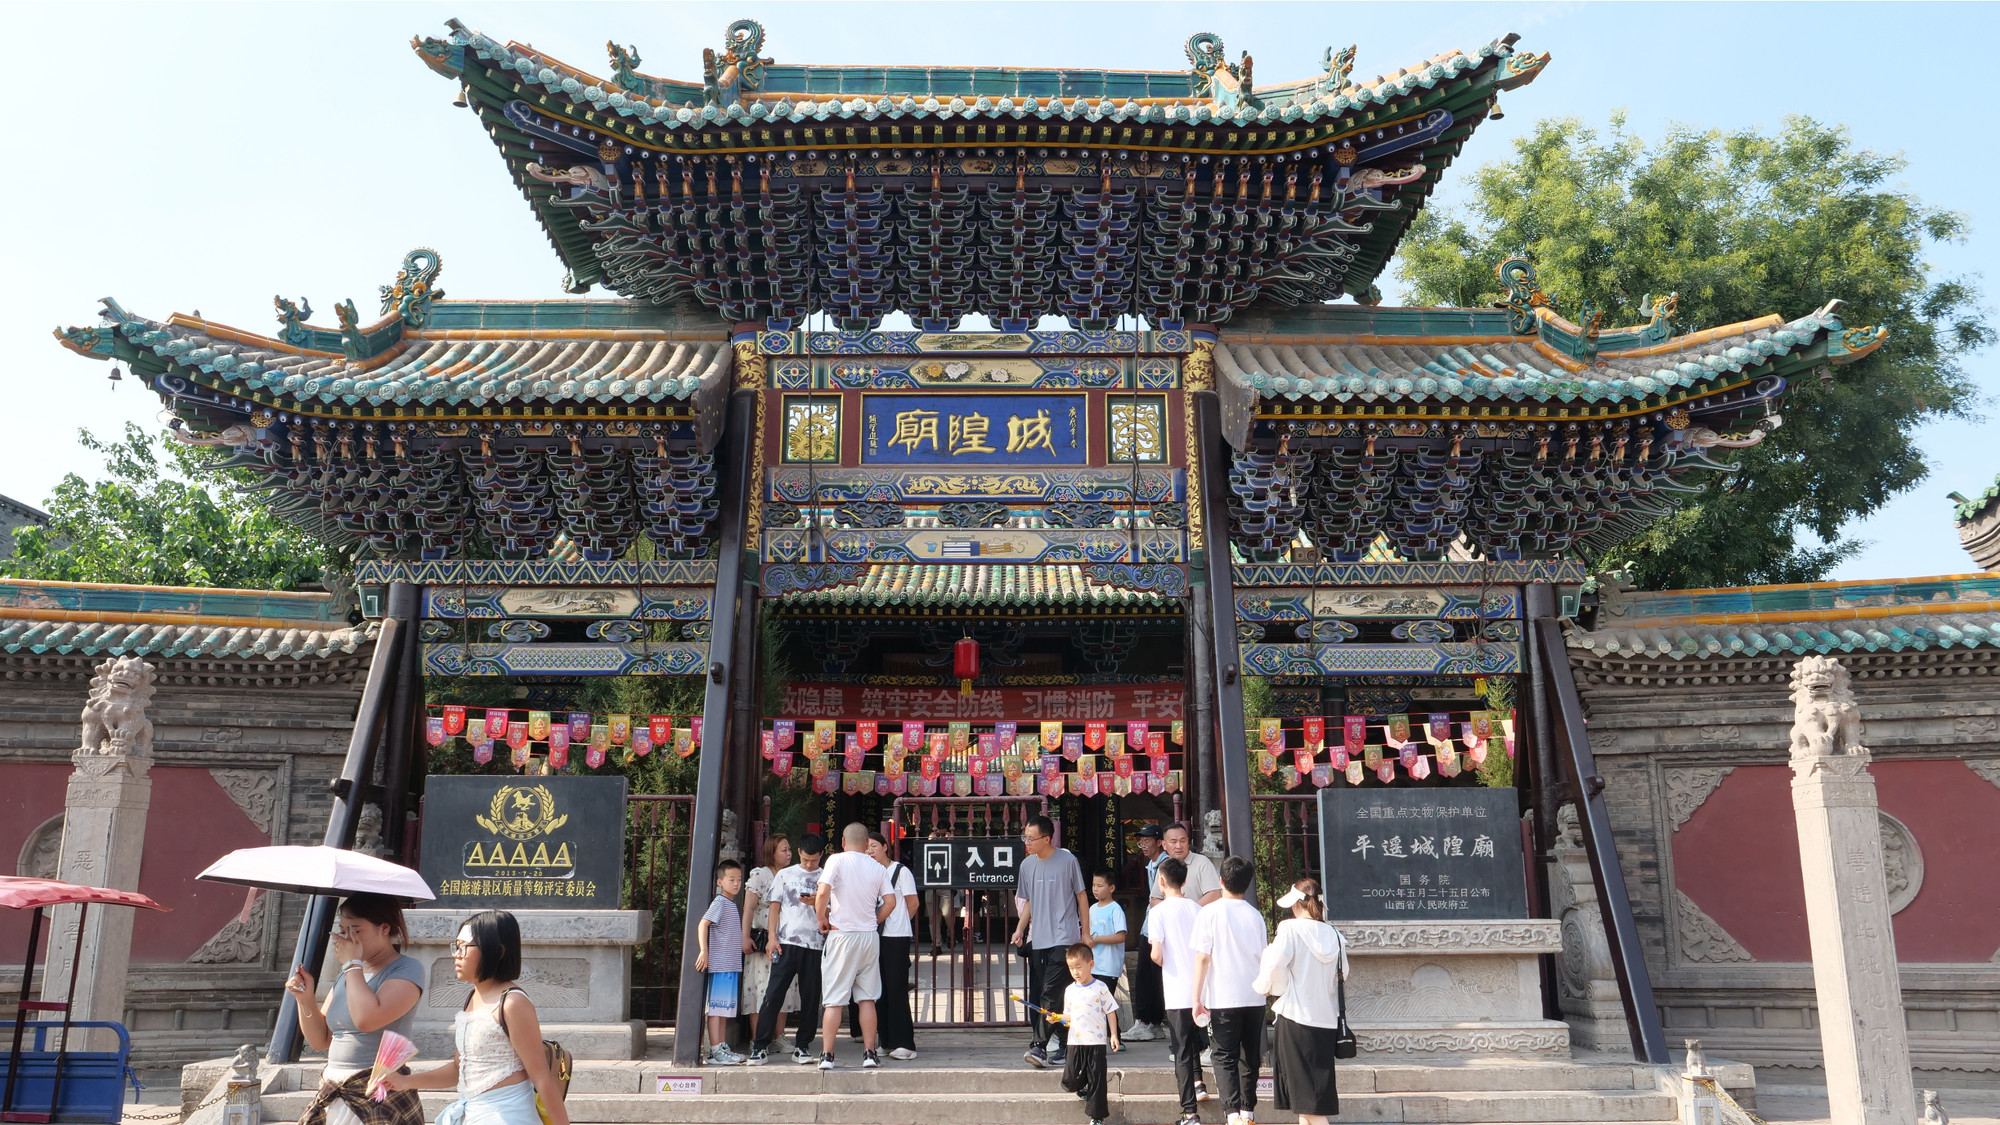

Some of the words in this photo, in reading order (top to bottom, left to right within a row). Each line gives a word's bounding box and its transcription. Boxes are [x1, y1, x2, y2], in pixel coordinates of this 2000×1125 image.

[860, 688, 1005, 718] 筑牢安全防线
[1022, 689, 1116, 719] 习惯消防
[1131, 689, 1183, 719] 平安
[1356, 806, 1488, 819] 全国重点文物保护单位
[465, 842, 573, 867] AAAAA
[965, 846, 1013, 869] 入口
[969, 872, 1015, 883] Entrance
[1399, 874, 1450, 886] 国务院
[439, 879, 596, 897] 全国旅游景区质量等级评定委员会
[1384, 900, 1469, 910] 山西省人民政府立
